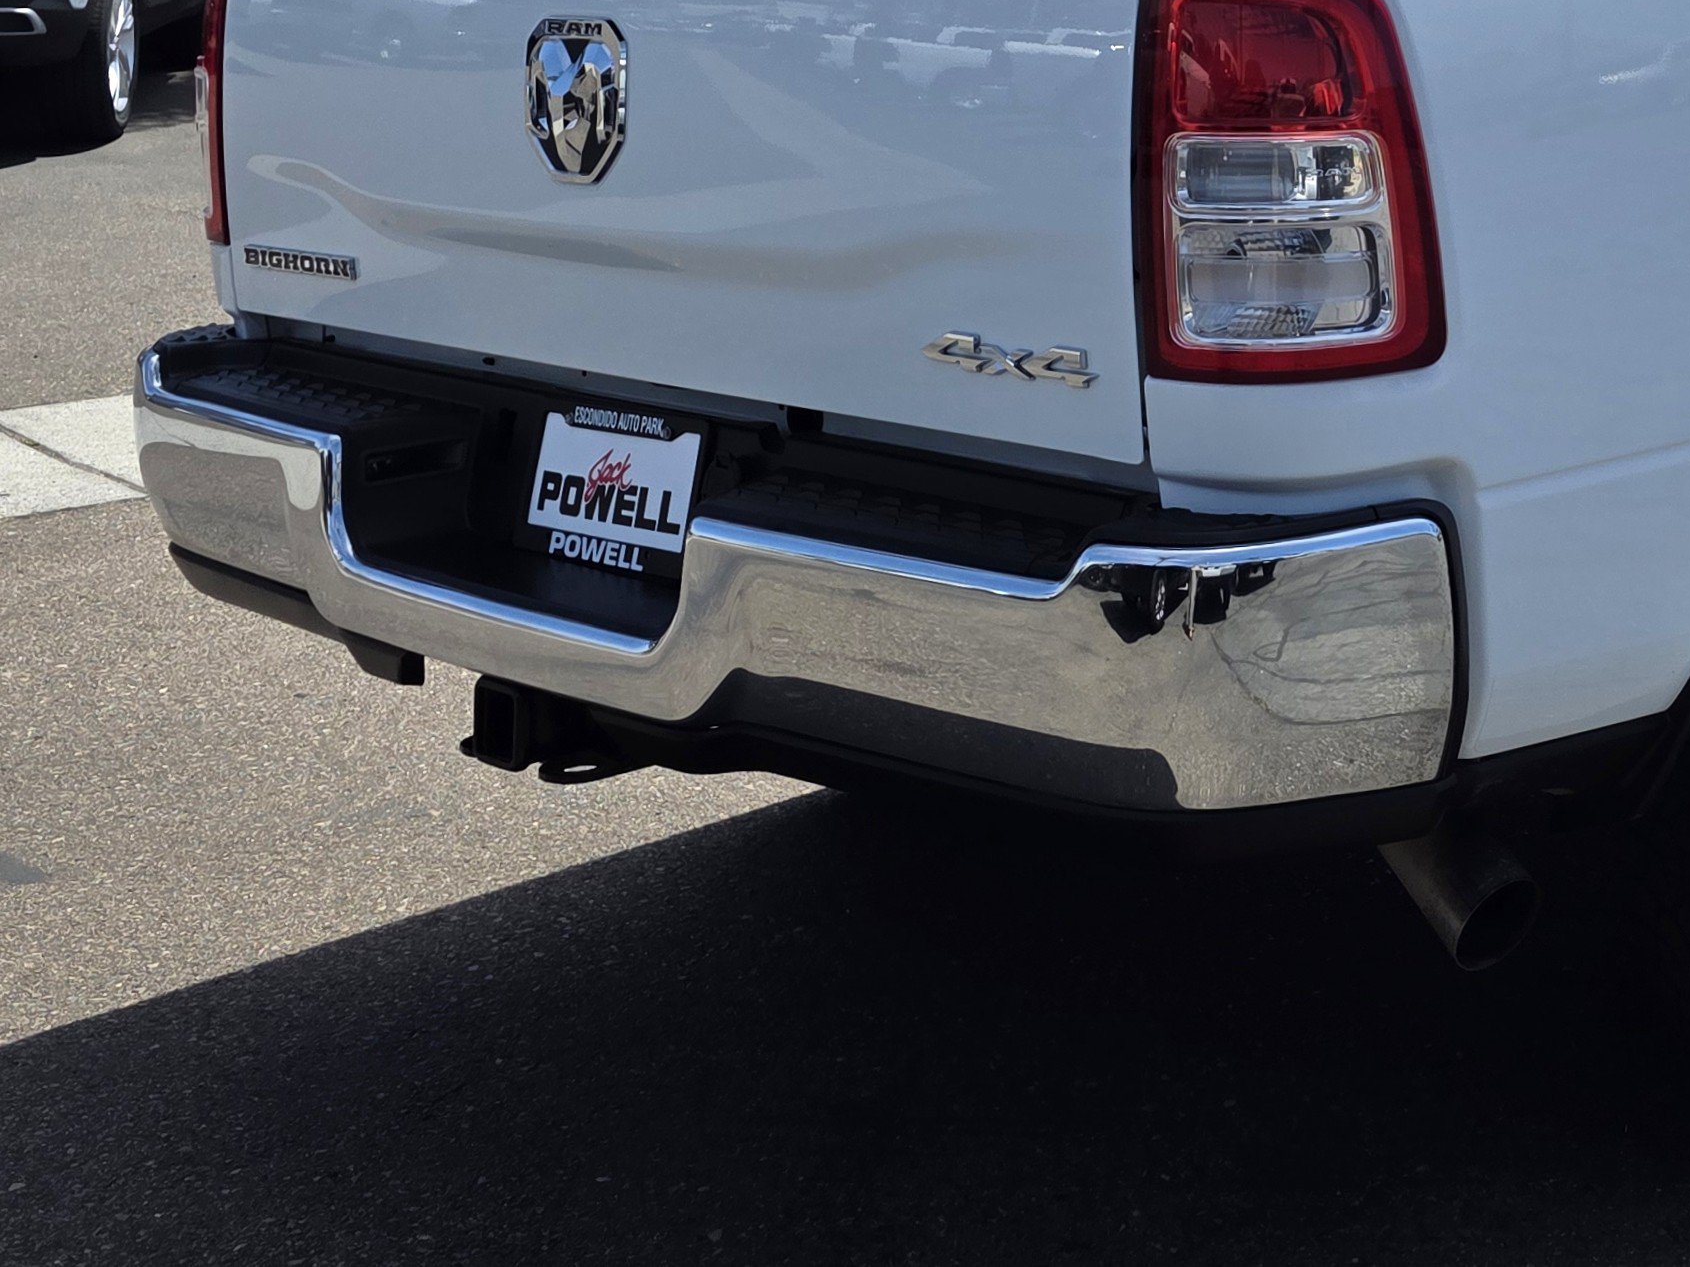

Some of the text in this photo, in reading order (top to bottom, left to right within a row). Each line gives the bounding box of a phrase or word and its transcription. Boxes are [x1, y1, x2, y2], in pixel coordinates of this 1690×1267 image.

[545, 19, 603, 36] RAM
[243, 247, 352, 278] BIGHORN
[574, 405, 665, 437] ESCONDIDO AUTO PARK
[584, 448, 633, 502] Jack
[537, 470, 681, 535] POWELL
[548, 531, 643, 572] POWELL
